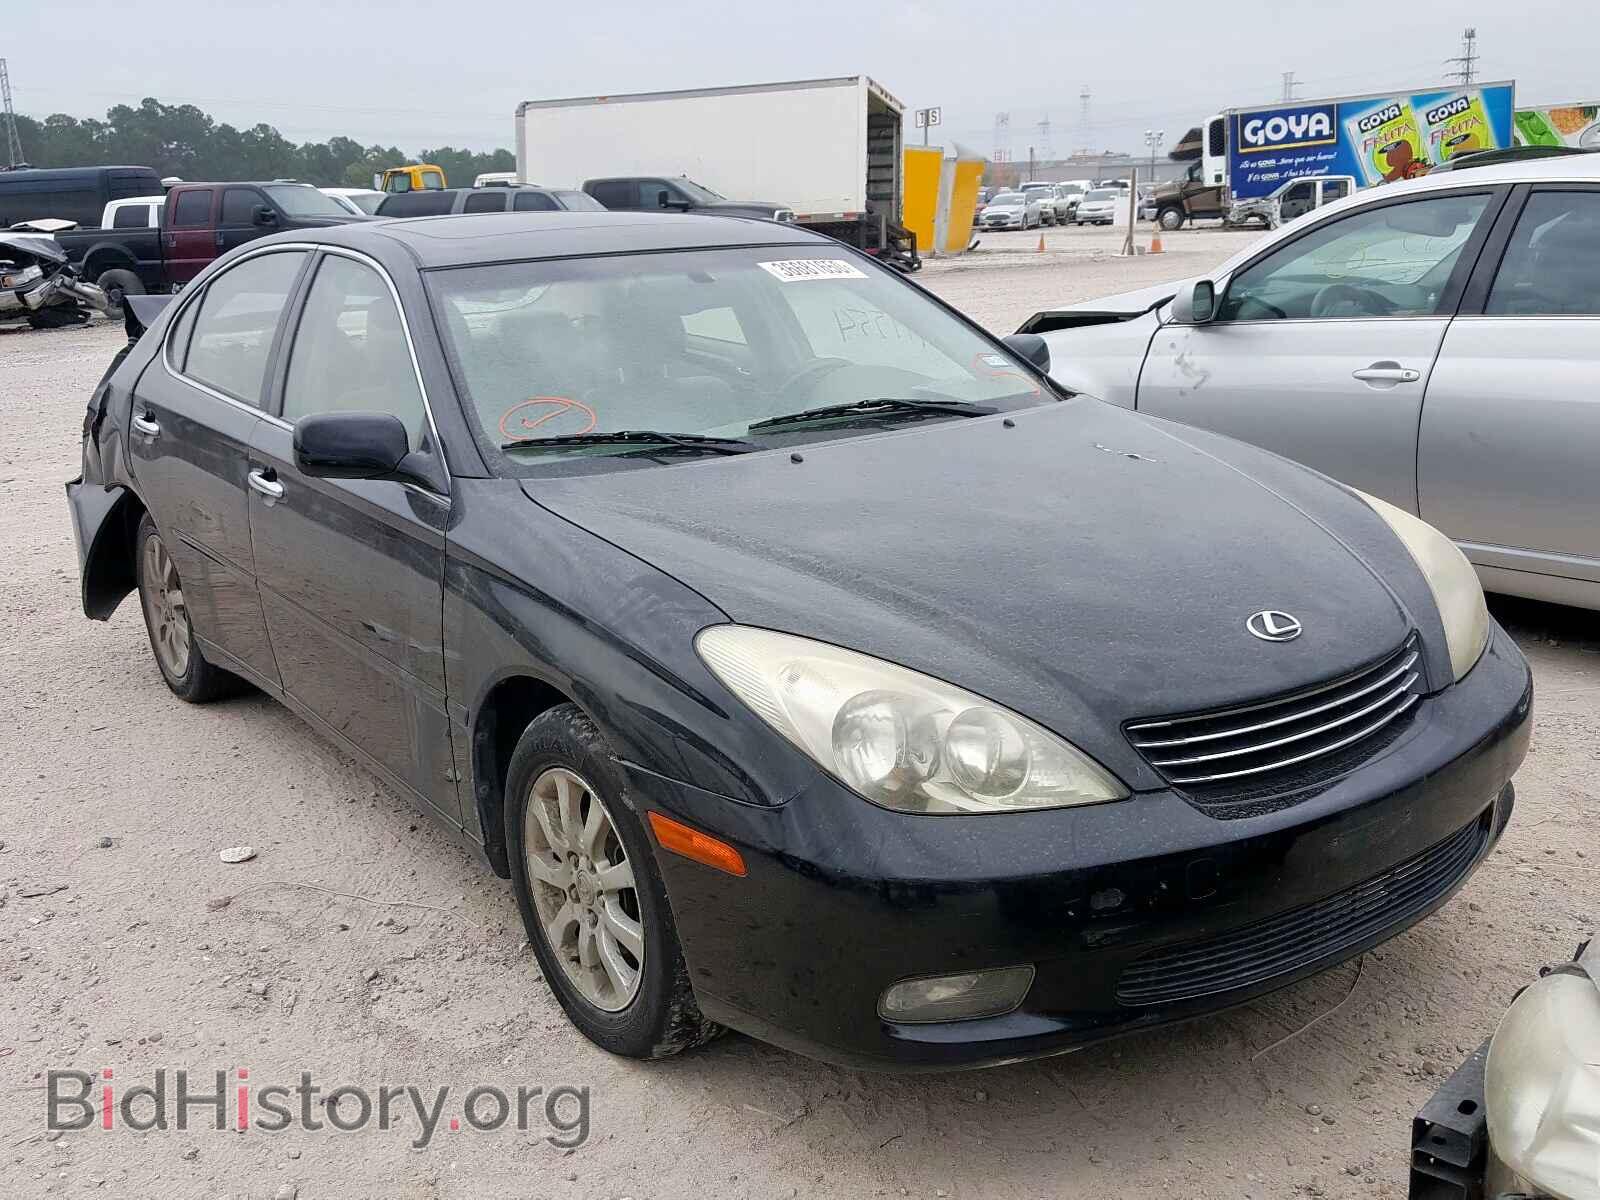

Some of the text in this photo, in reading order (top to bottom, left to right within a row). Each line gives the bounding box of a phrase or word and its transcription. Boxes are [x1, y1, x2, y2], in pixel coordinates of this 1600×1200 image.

[931, 110, 937, 123] S
[1360, 105, 1400, 131] GOYA
[1428, 98, 1468, 123] GOYA
[1244, 112, 1331, 145] GOYA
